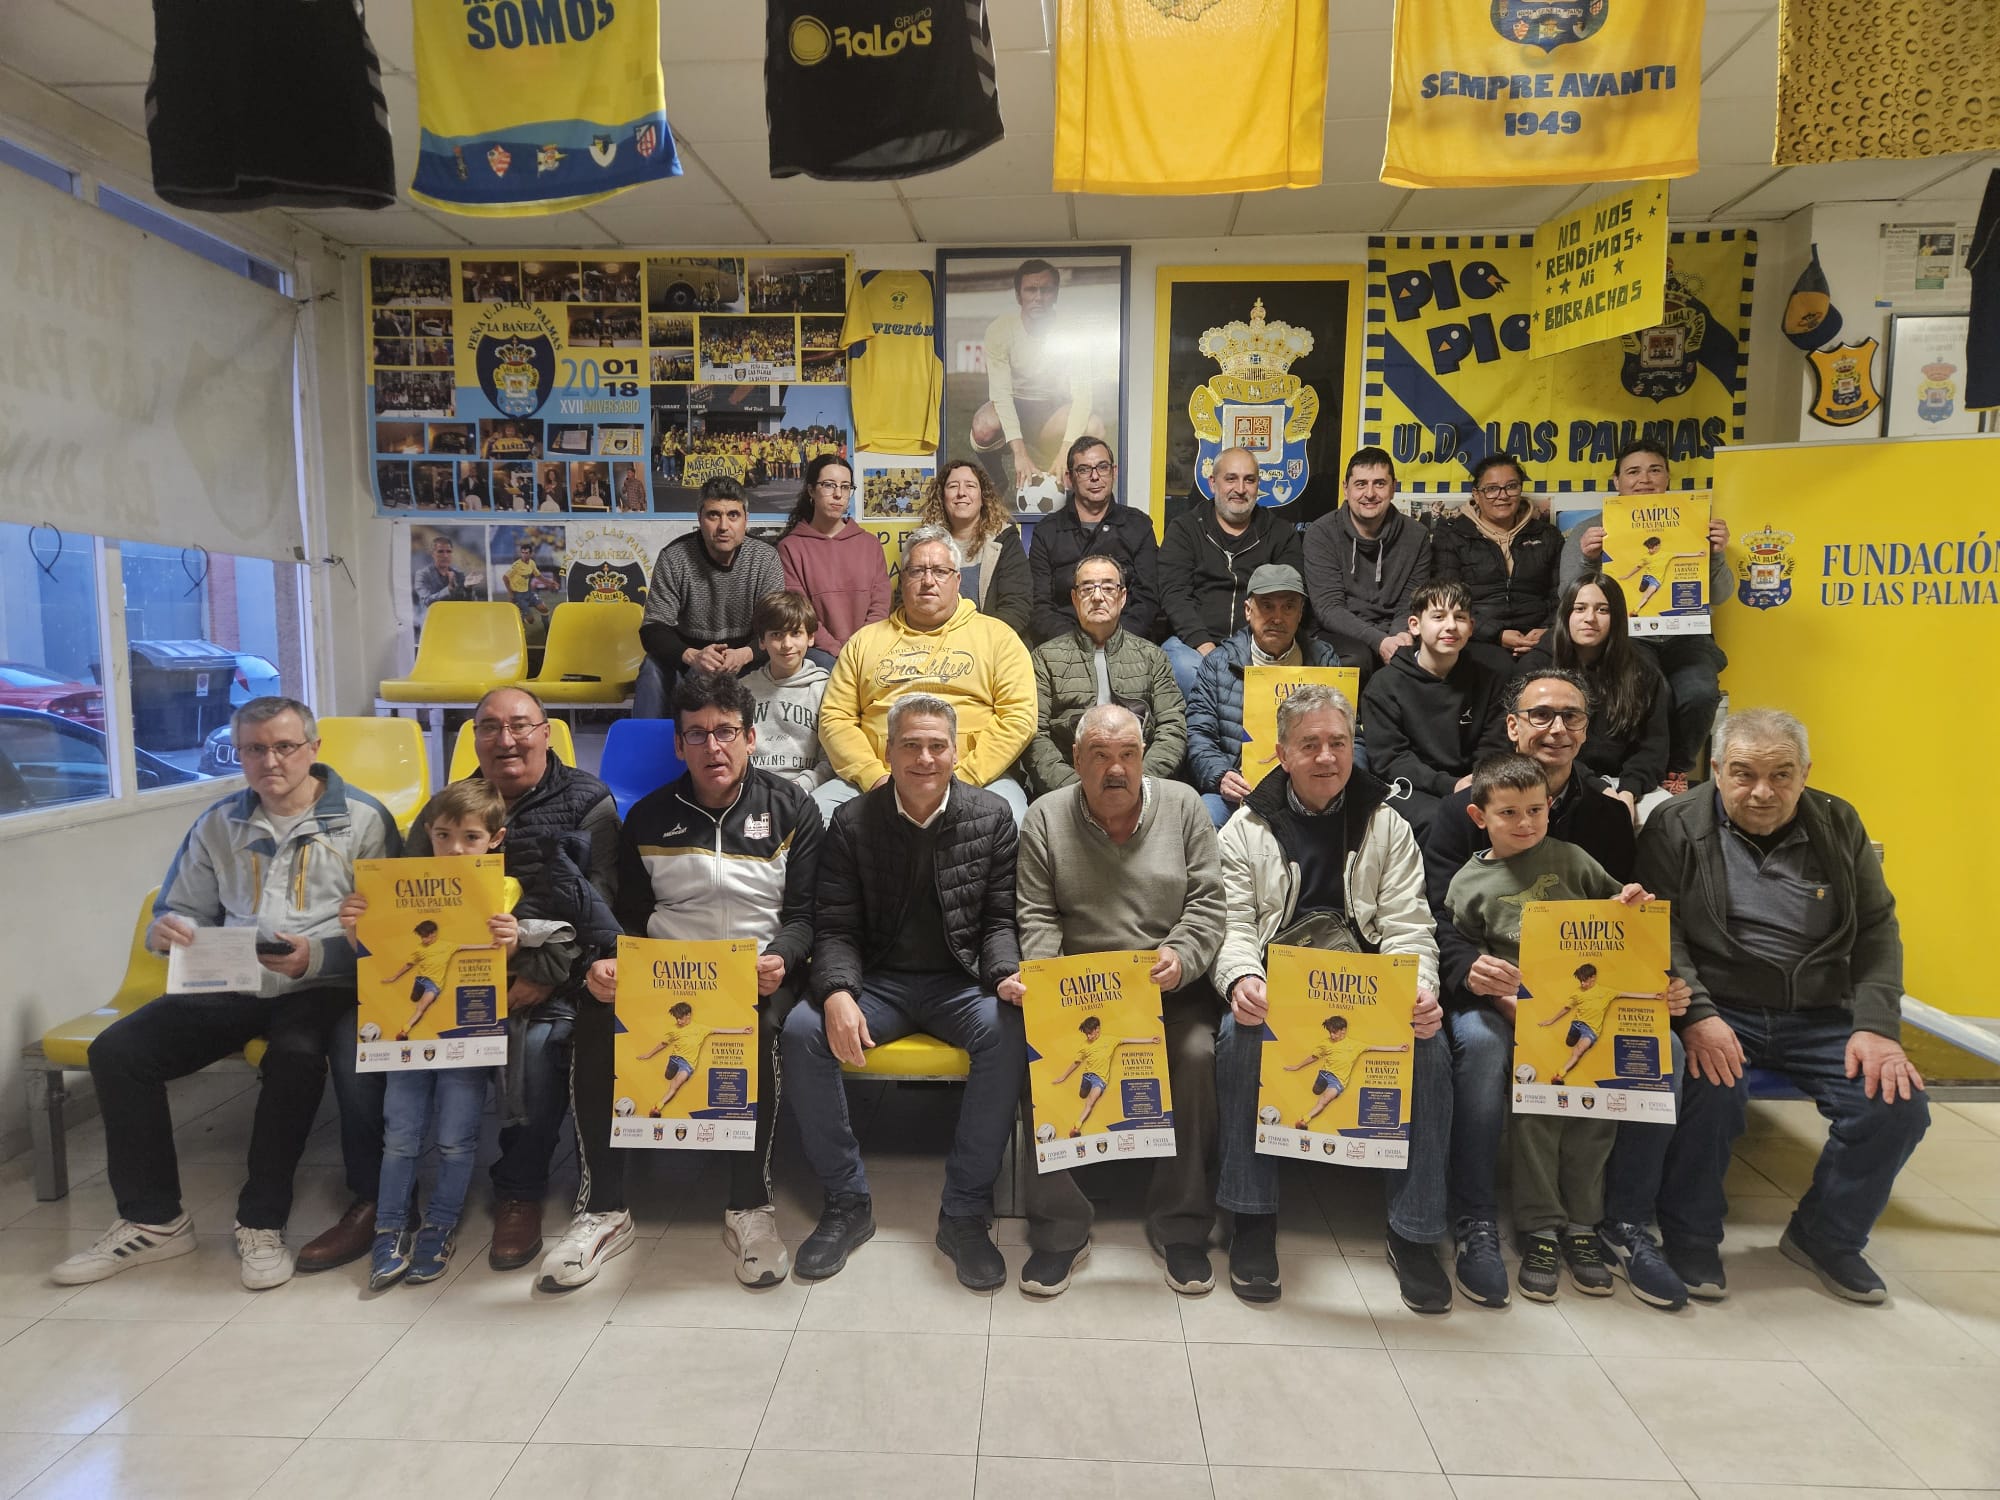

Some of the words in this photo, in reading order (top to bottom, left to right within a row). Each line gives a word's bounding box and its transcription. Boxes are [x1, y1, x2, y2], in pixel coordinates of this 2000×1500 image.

[467, 0, 615, 49] SOMOS
[894, 8, 932, 30] GRUPO
[1421, 73, 1555, 101] SEMPRE
[1558, 65, 1677, 99] AVANTI
[1504, 111, 1582, 137] 1949
[1558, 220, 1580, 251] NO
[1594, 200, 1633, 236] NOS
[1386, 260, 1511, 323] PIC
[1544, 280, 1642, 332] BORRACHOS
[487, 322, 501, 334] LA
[502, 319, 544, 335] BAÑEZA
[534, 306, 564, 351] PALMAS
[561, 358, 600, 398] 20
[602, 359, 639, 375] 01
[603, 381, 640, 398] 18
[584, 400, 640, 414] ANIVERSARIO
[1392, 422, 1468, 465] U.D.
[1484, 421, 1560, 463] LAS
[1631, 507, 1680, 522] CAMPUS
[1821, 582, 1854, 606] UD
[1862, 581, 1904, 606] LAS
[1911, 580, 2000, 605] PALMA
[395, 878, 463, 897] CAMPUS
[1560, 921, 1624, 940] CAMPUS
[1589, 940, 1625, 951] PALMAS
[653, 960, 718, 980] CAMPUS
[667, 980, 682, 989] LAS
[683, 981, 718, 990] PALMAS
[1059, 972, 1121, 996] CAMPUS
[1308, 970, 1378, 995] CAMPUS
[1074, 994, 1089, 1006] LAS
[1090, 990, 1122, 1003] PALMAS
[1323, 991, 1338, 1003] LAS
[1340, 993, 1377, 1006] PALMAS
